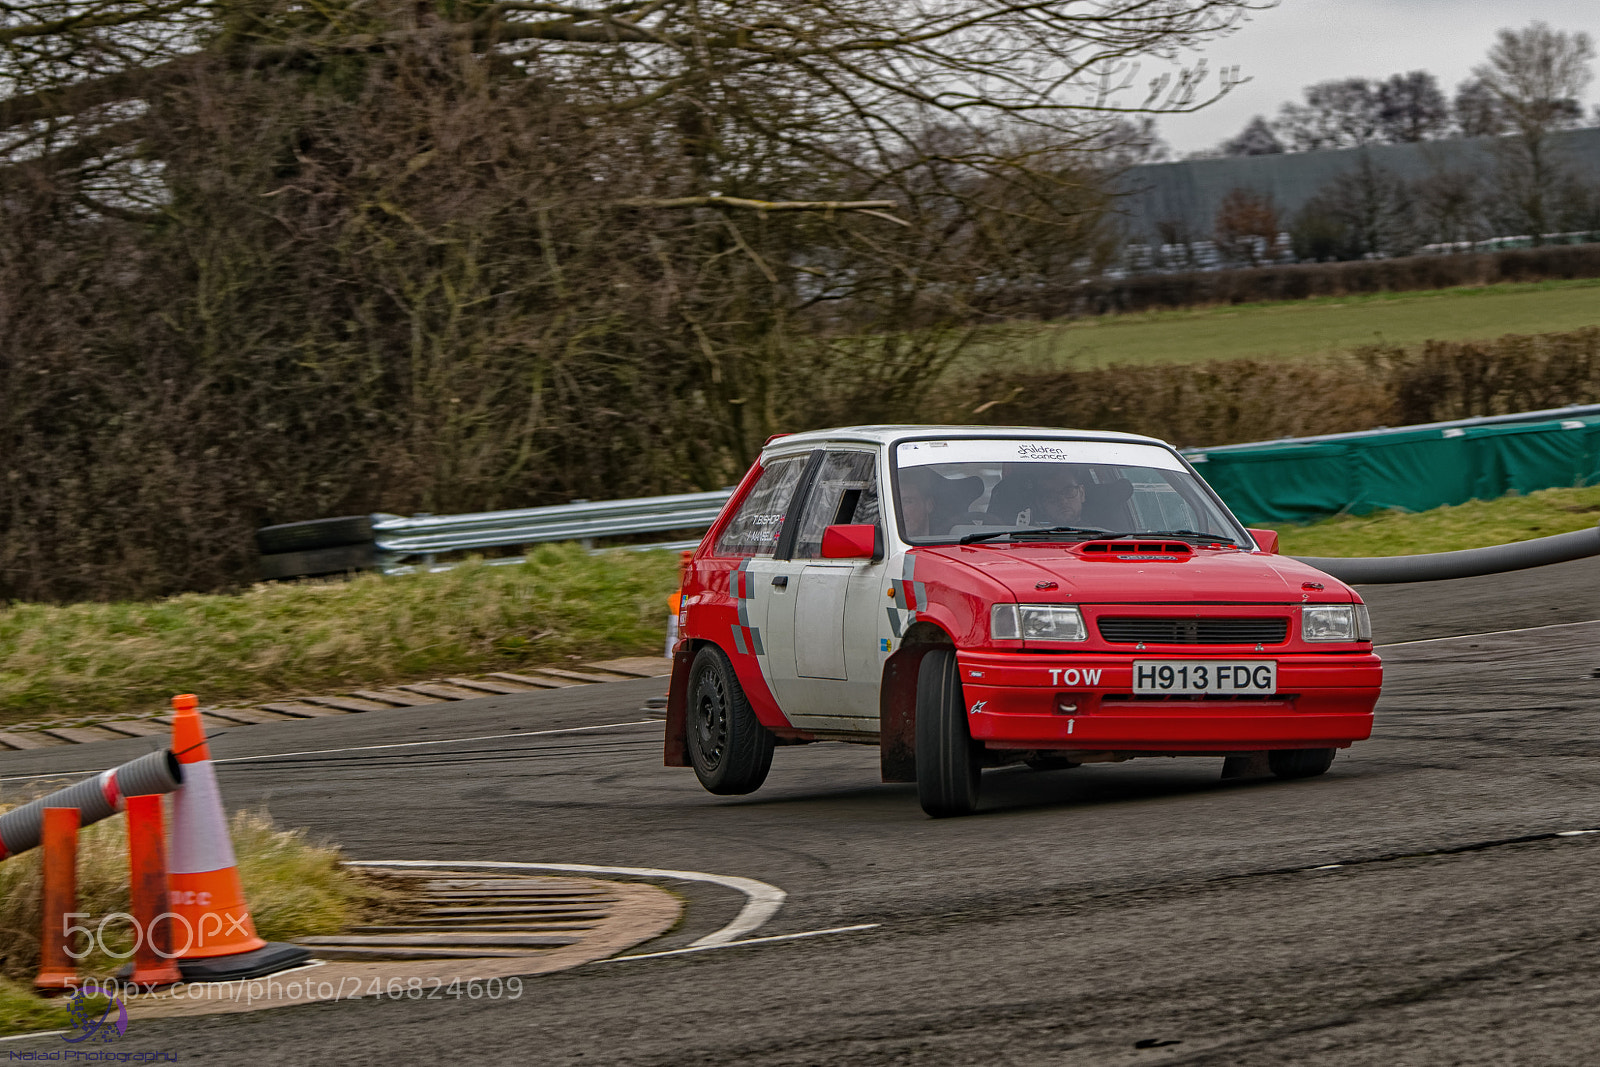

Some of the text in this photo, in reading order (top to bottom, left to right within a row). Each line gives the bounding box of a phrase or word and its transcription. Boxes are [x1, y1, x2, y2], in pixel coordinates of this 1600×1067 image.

[1048, 669, 1103, 686] TOW
[1137, 665, 1272, 689] H913 FDG
